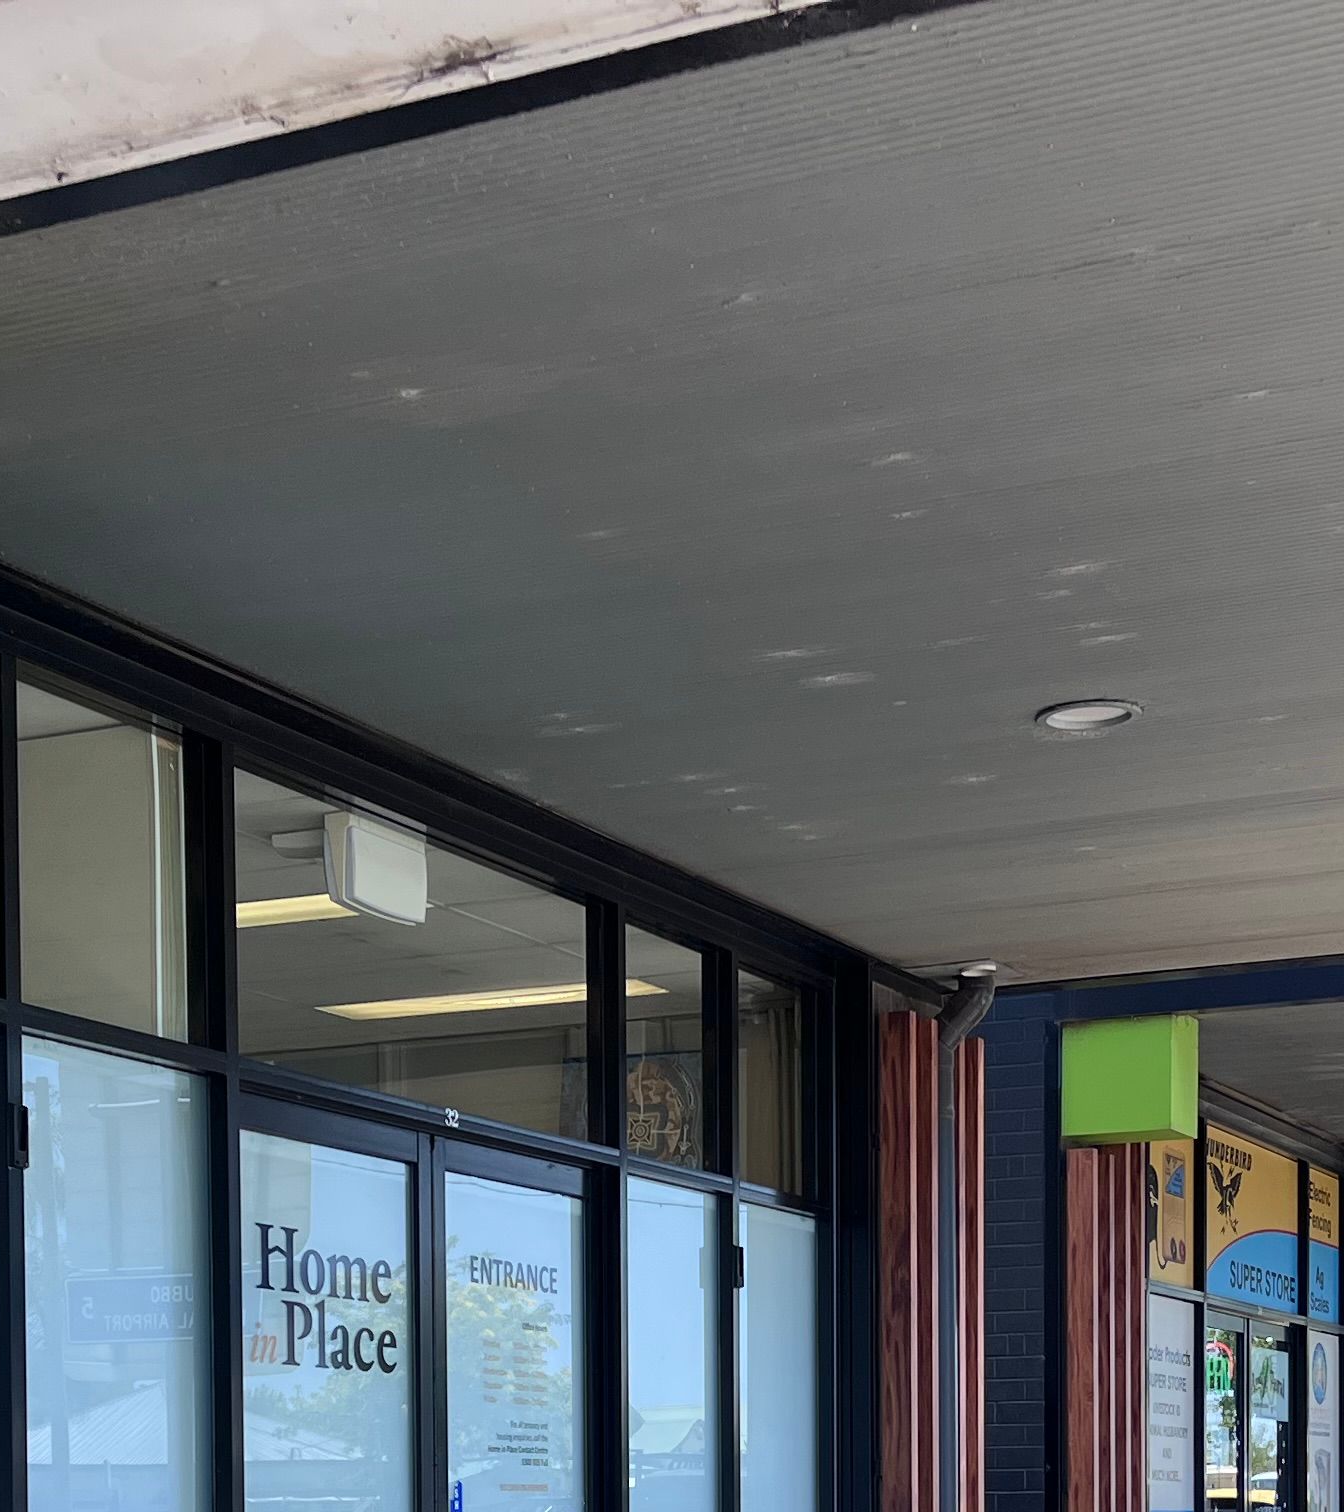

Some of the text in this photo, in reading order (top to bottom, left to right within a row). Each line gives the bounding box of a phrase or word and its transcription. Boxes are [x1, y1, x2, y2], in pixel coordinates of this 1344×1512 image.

[445, 1108, 459, 1128] 32
[255, 1222, 392, 1304] Home
[470, 1255, 558, 1294] ENTRANCE
[1229, 1260, 1296, 1303] SUPER STORE
[250, 1299, 397, 1374] in Place
